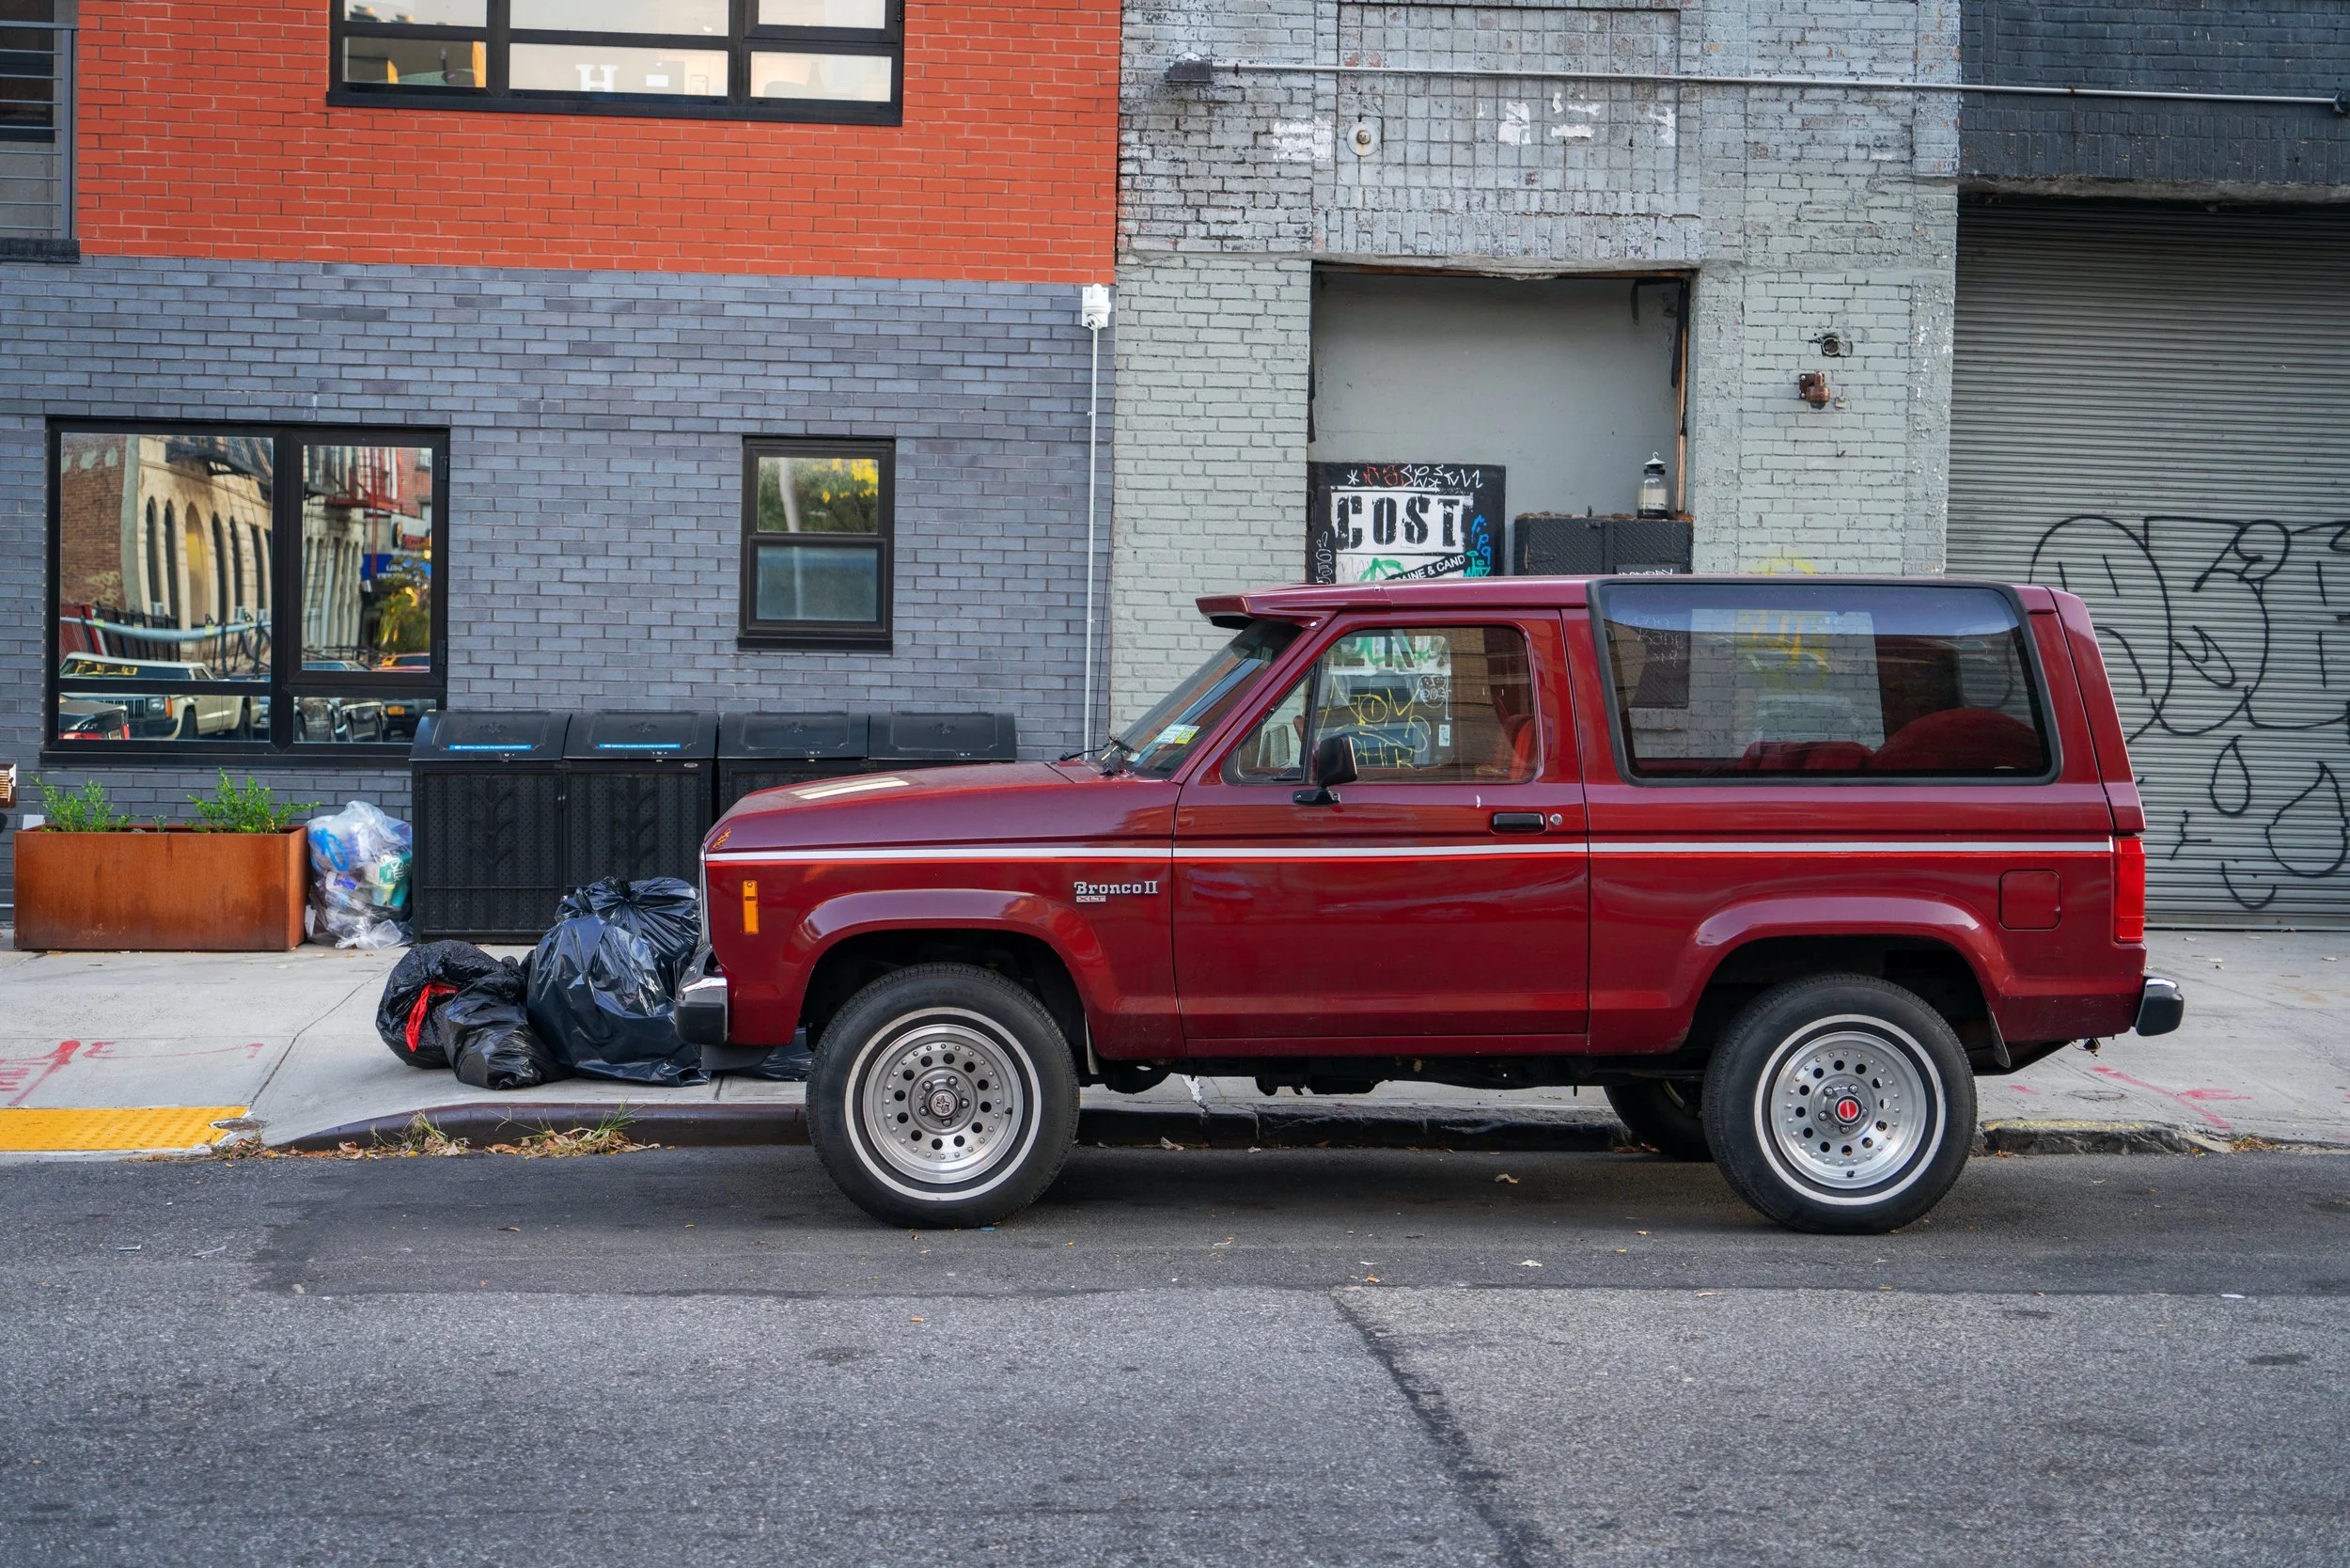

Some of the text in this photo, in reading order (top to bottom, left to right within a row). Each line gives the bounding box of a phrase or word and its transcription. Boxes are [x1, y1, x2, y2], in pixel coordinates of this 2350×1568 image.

[575, 63, 619, 92] H
[1335, 494, 1460, 550] COST
[1427, 565, 1435, 576] &
[1073, 880, 1159, 895] Bronco II
